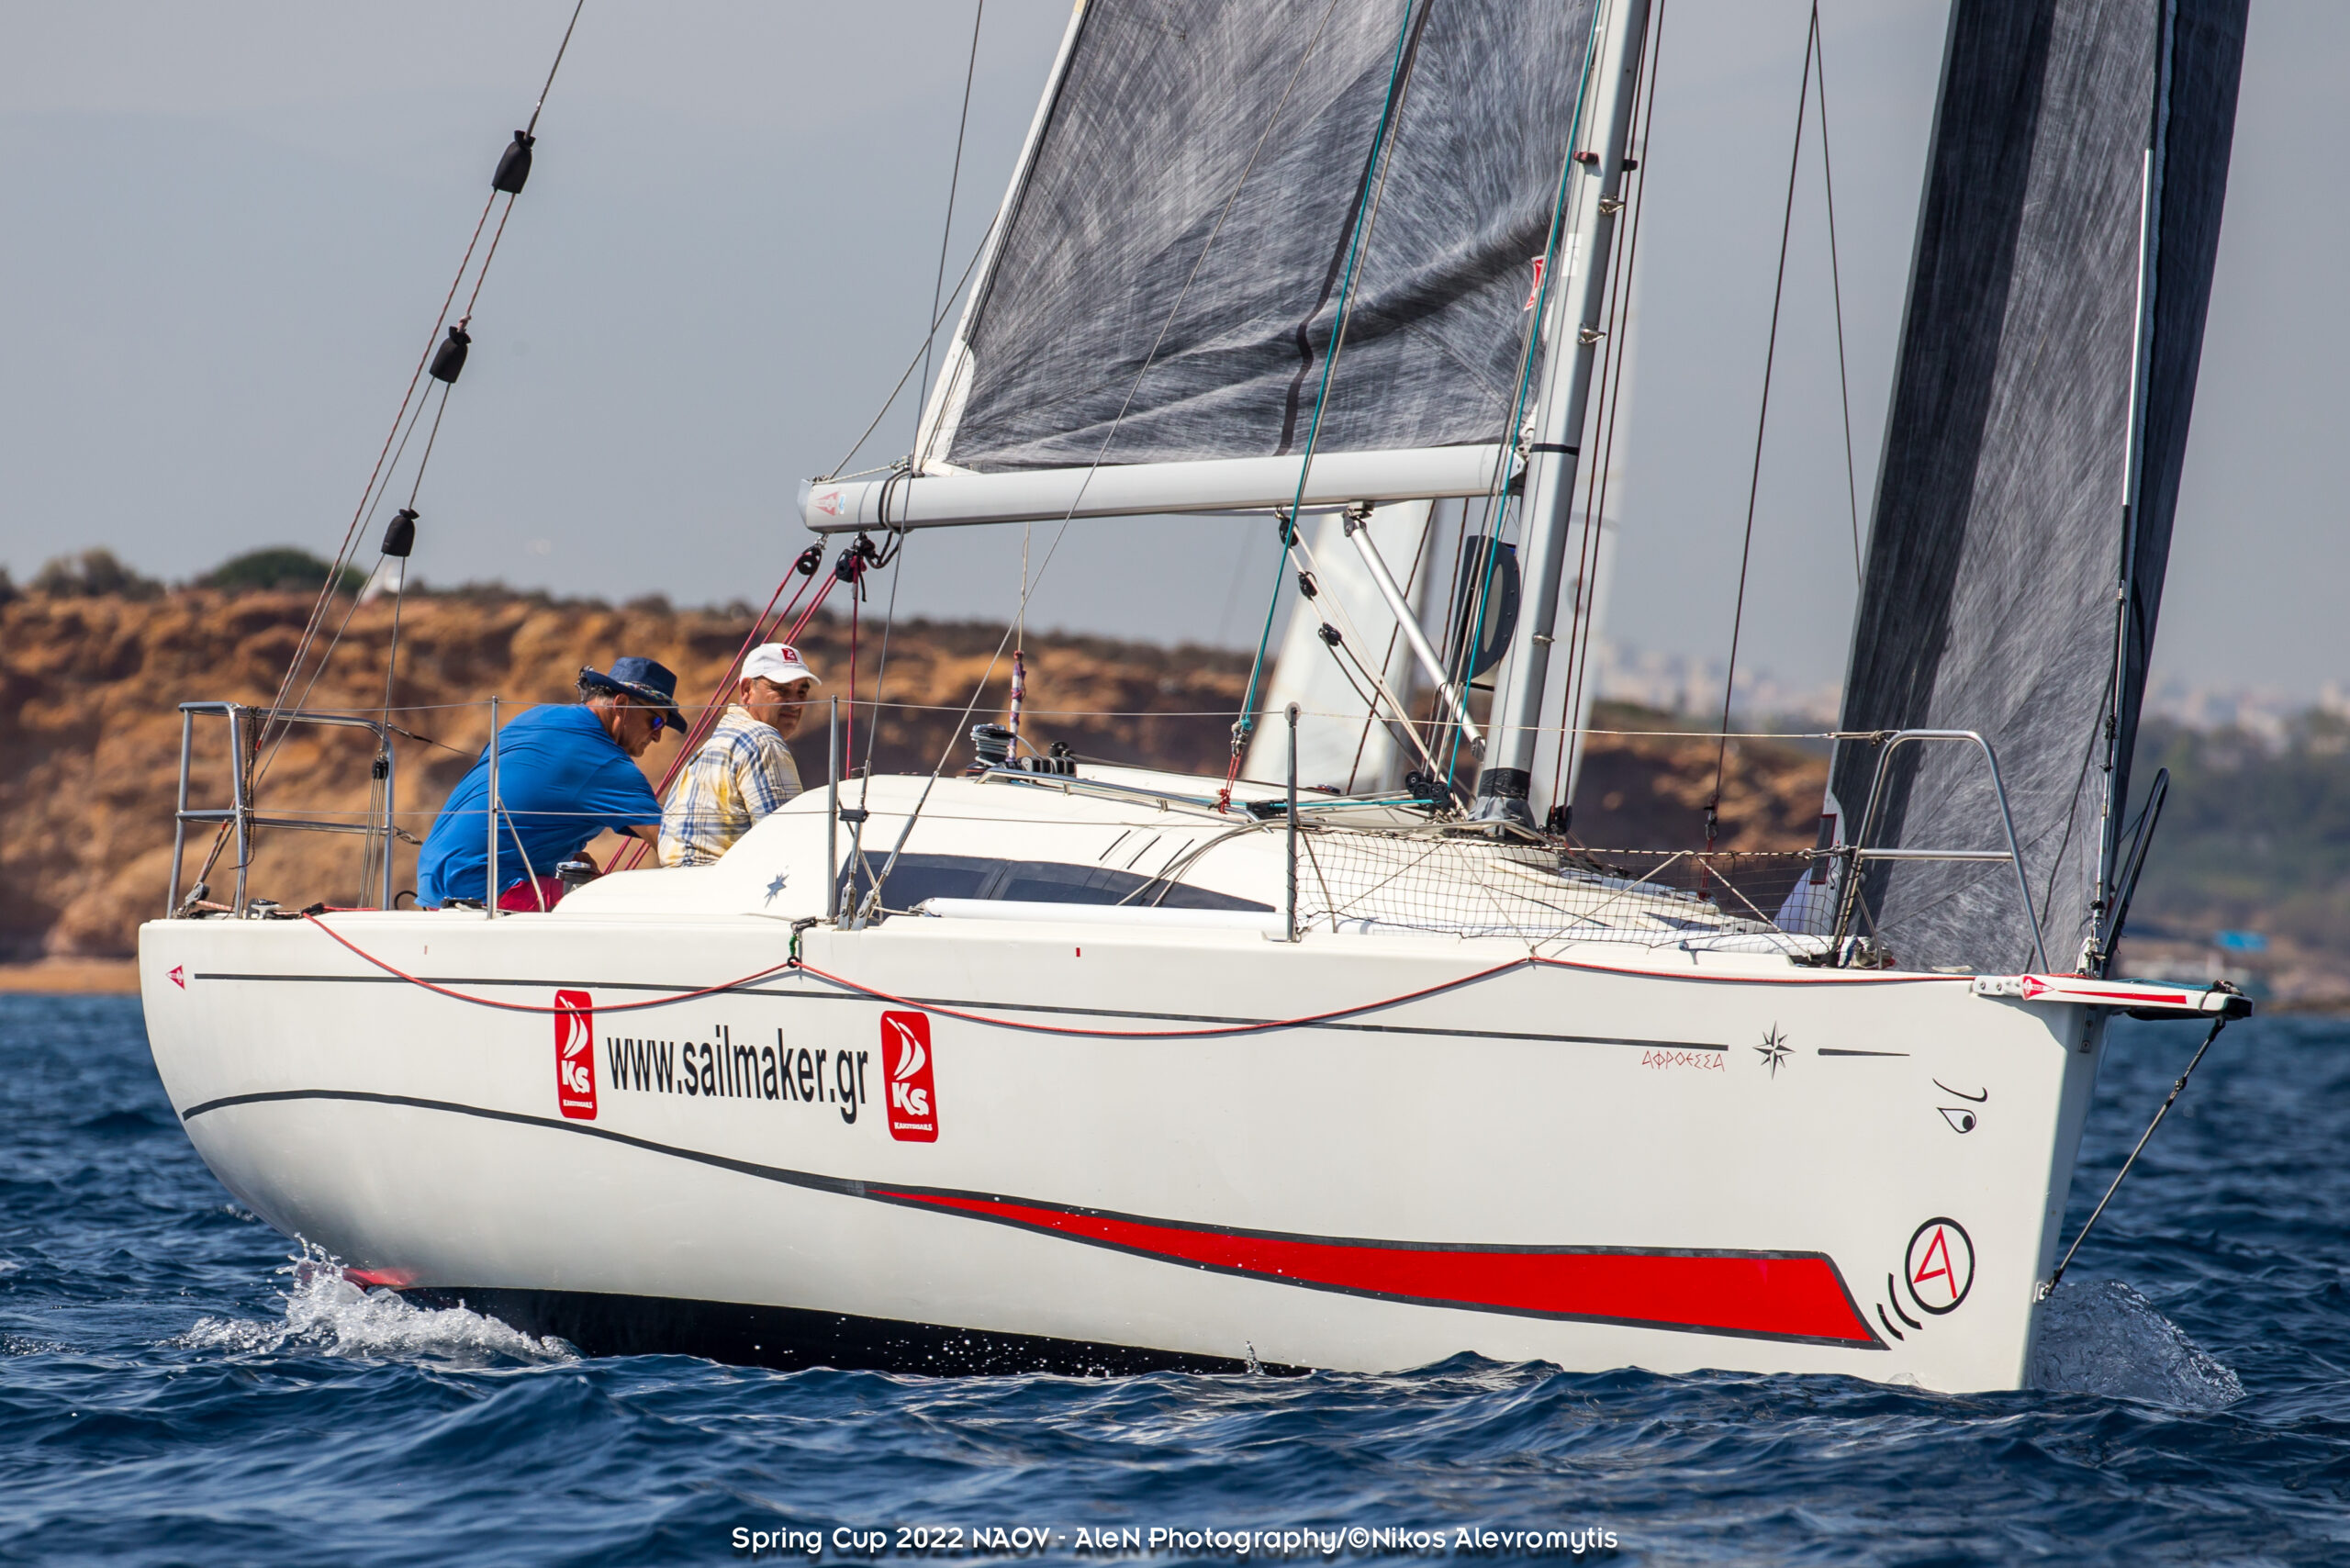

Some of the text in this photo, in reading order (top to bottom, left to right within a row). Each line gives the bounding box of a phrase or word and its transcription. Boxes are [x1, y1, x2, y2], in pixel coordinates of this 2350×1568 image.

[561, 1059, 591, 1093] KS
[607, 1025, 868, 1125] www.sailmaker.gr
[1641, 1050, 1726, 1072] ΑΦΡΟΕΣΣΑ
[891, 1081, 930, 1116] KS
